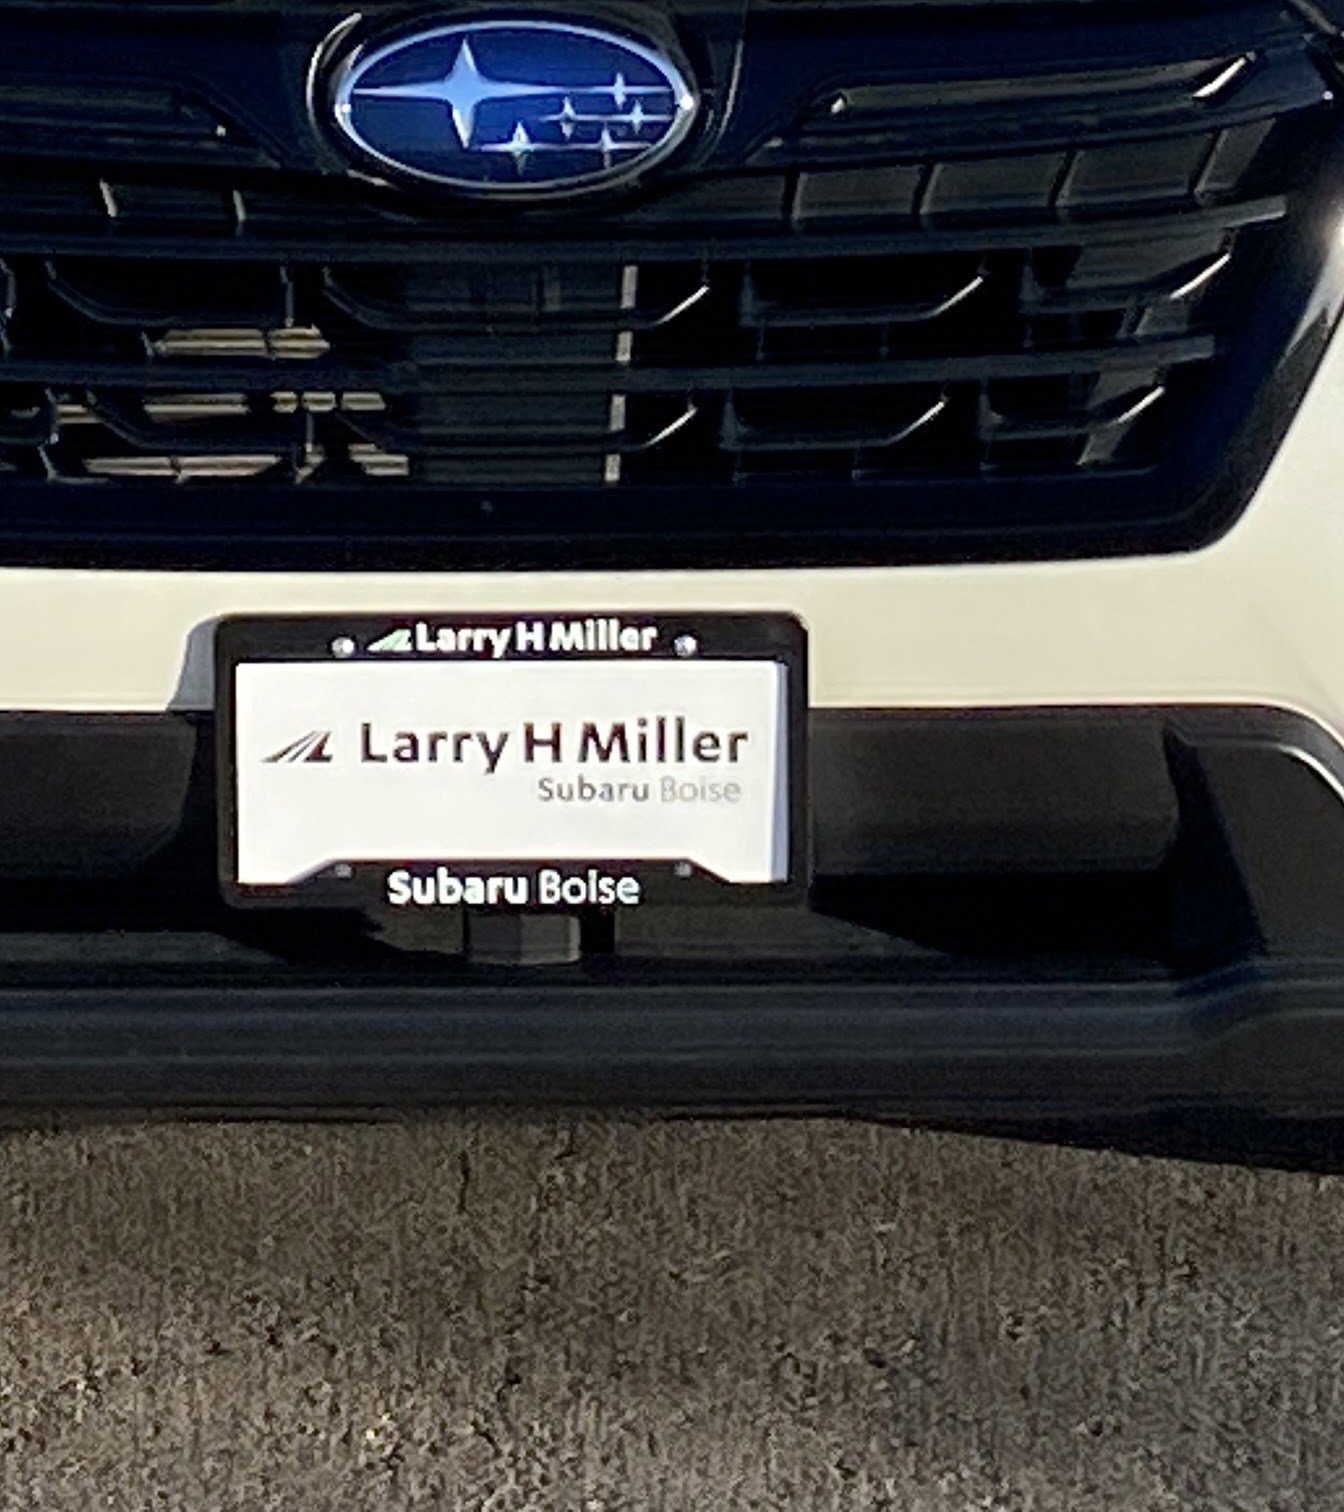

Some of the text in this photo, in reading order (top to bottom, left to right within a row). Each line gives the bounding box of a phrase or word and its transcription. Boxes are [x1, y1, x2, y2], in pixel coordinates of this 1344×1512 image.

[415, 619, 657, 658] Larry H Miller
[360, 716, 749, 774] Larry H Miller
[537, 775, 742, 803] Subaru Boise
[388, 869, 640, 905] Subaru Boise
